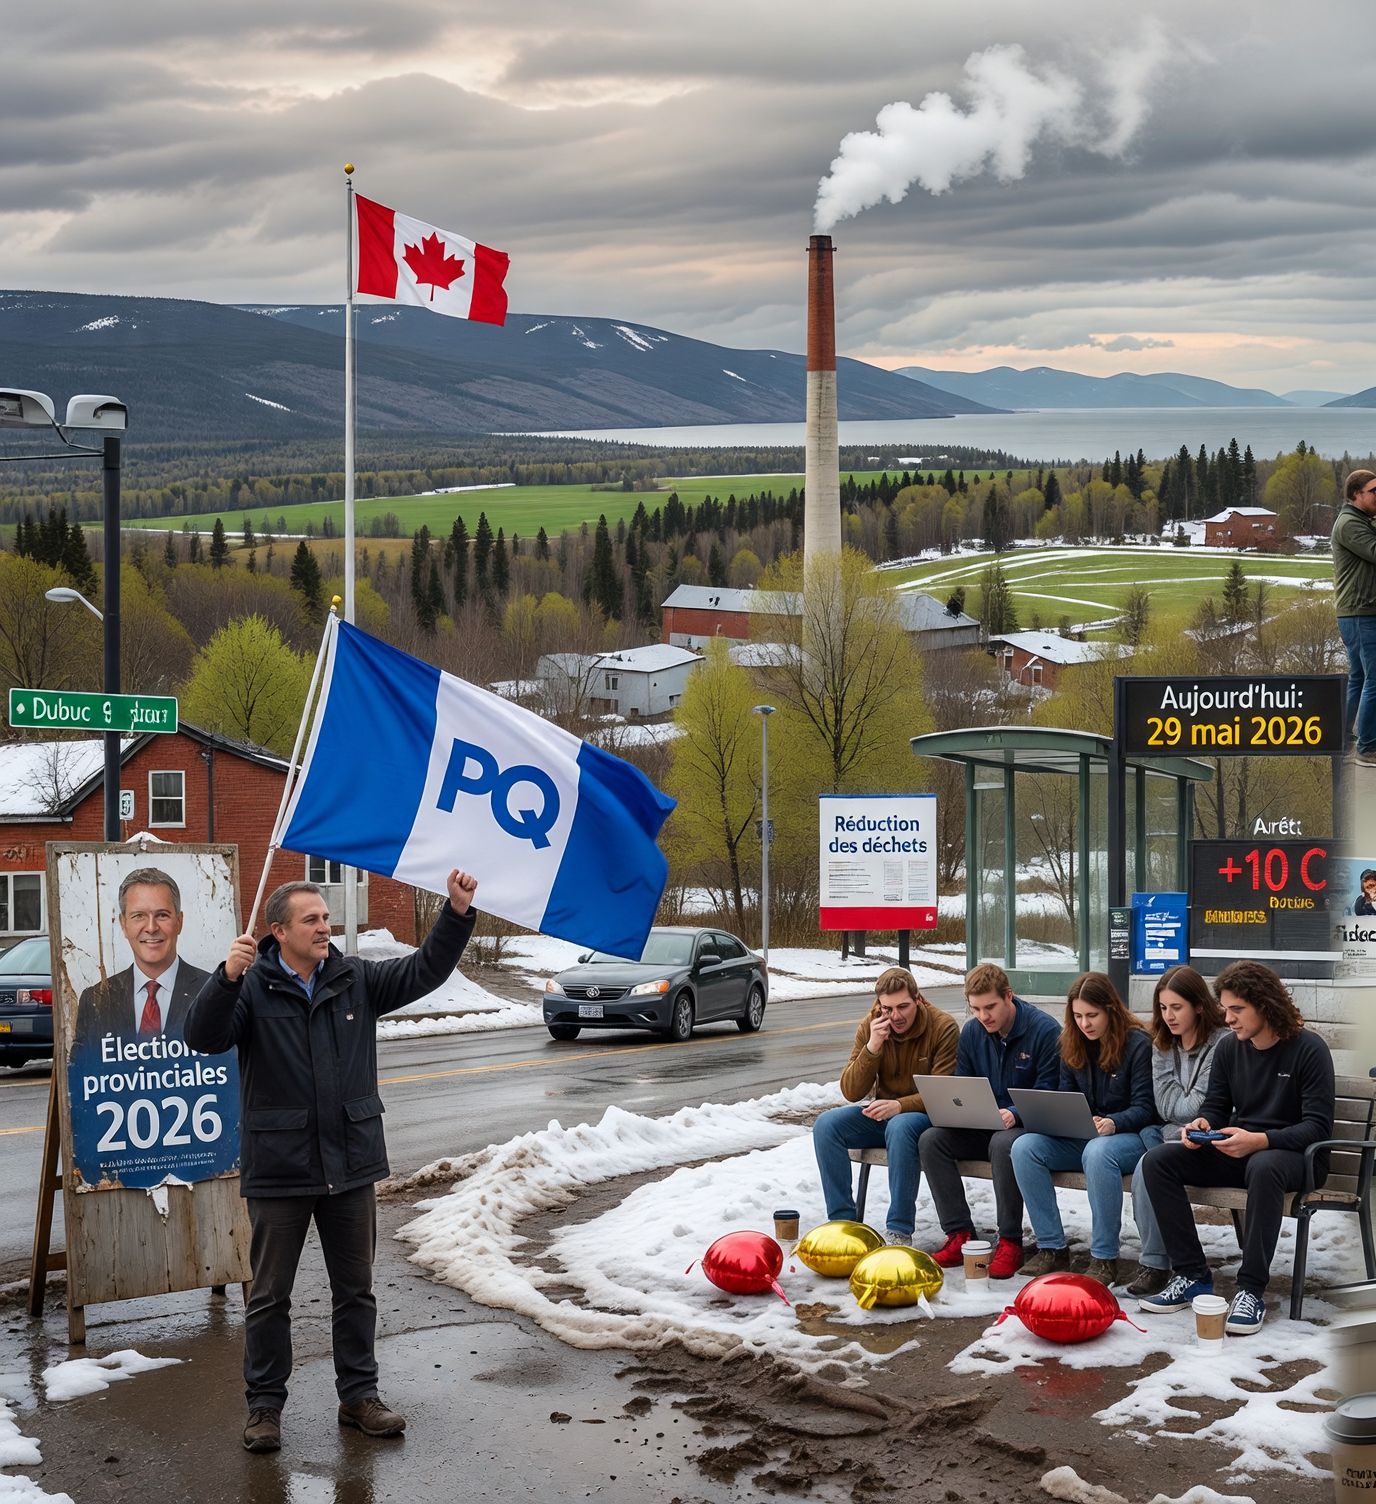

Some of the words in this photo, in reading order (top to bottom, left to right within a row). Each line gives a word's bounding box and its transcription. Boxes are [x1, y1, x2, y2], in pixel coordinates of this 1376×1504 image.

[32, 697, 91, 722] Dubuc
[1160, 683, 1304, 717] Aujourd'hui:
[1147, 716, 1182, 745] 29
[1191, 716, 1241, 746] mai
[1250, 716, 1322, 745] 2026
[436, 737, 560, 850] PQ
[835, 815, 920, 832] Réduction
[829, 837, 858, 853] des
[862, 836, 927, 853] déchets
[1218, 848, 1289, 892] +10
[1301, 847, 1327, 891] C
[101, 1032, 210, 1063] Élection
[83, 1061, 228, 1101] provinciales
[96, 1094, 223, 1153] 2026
